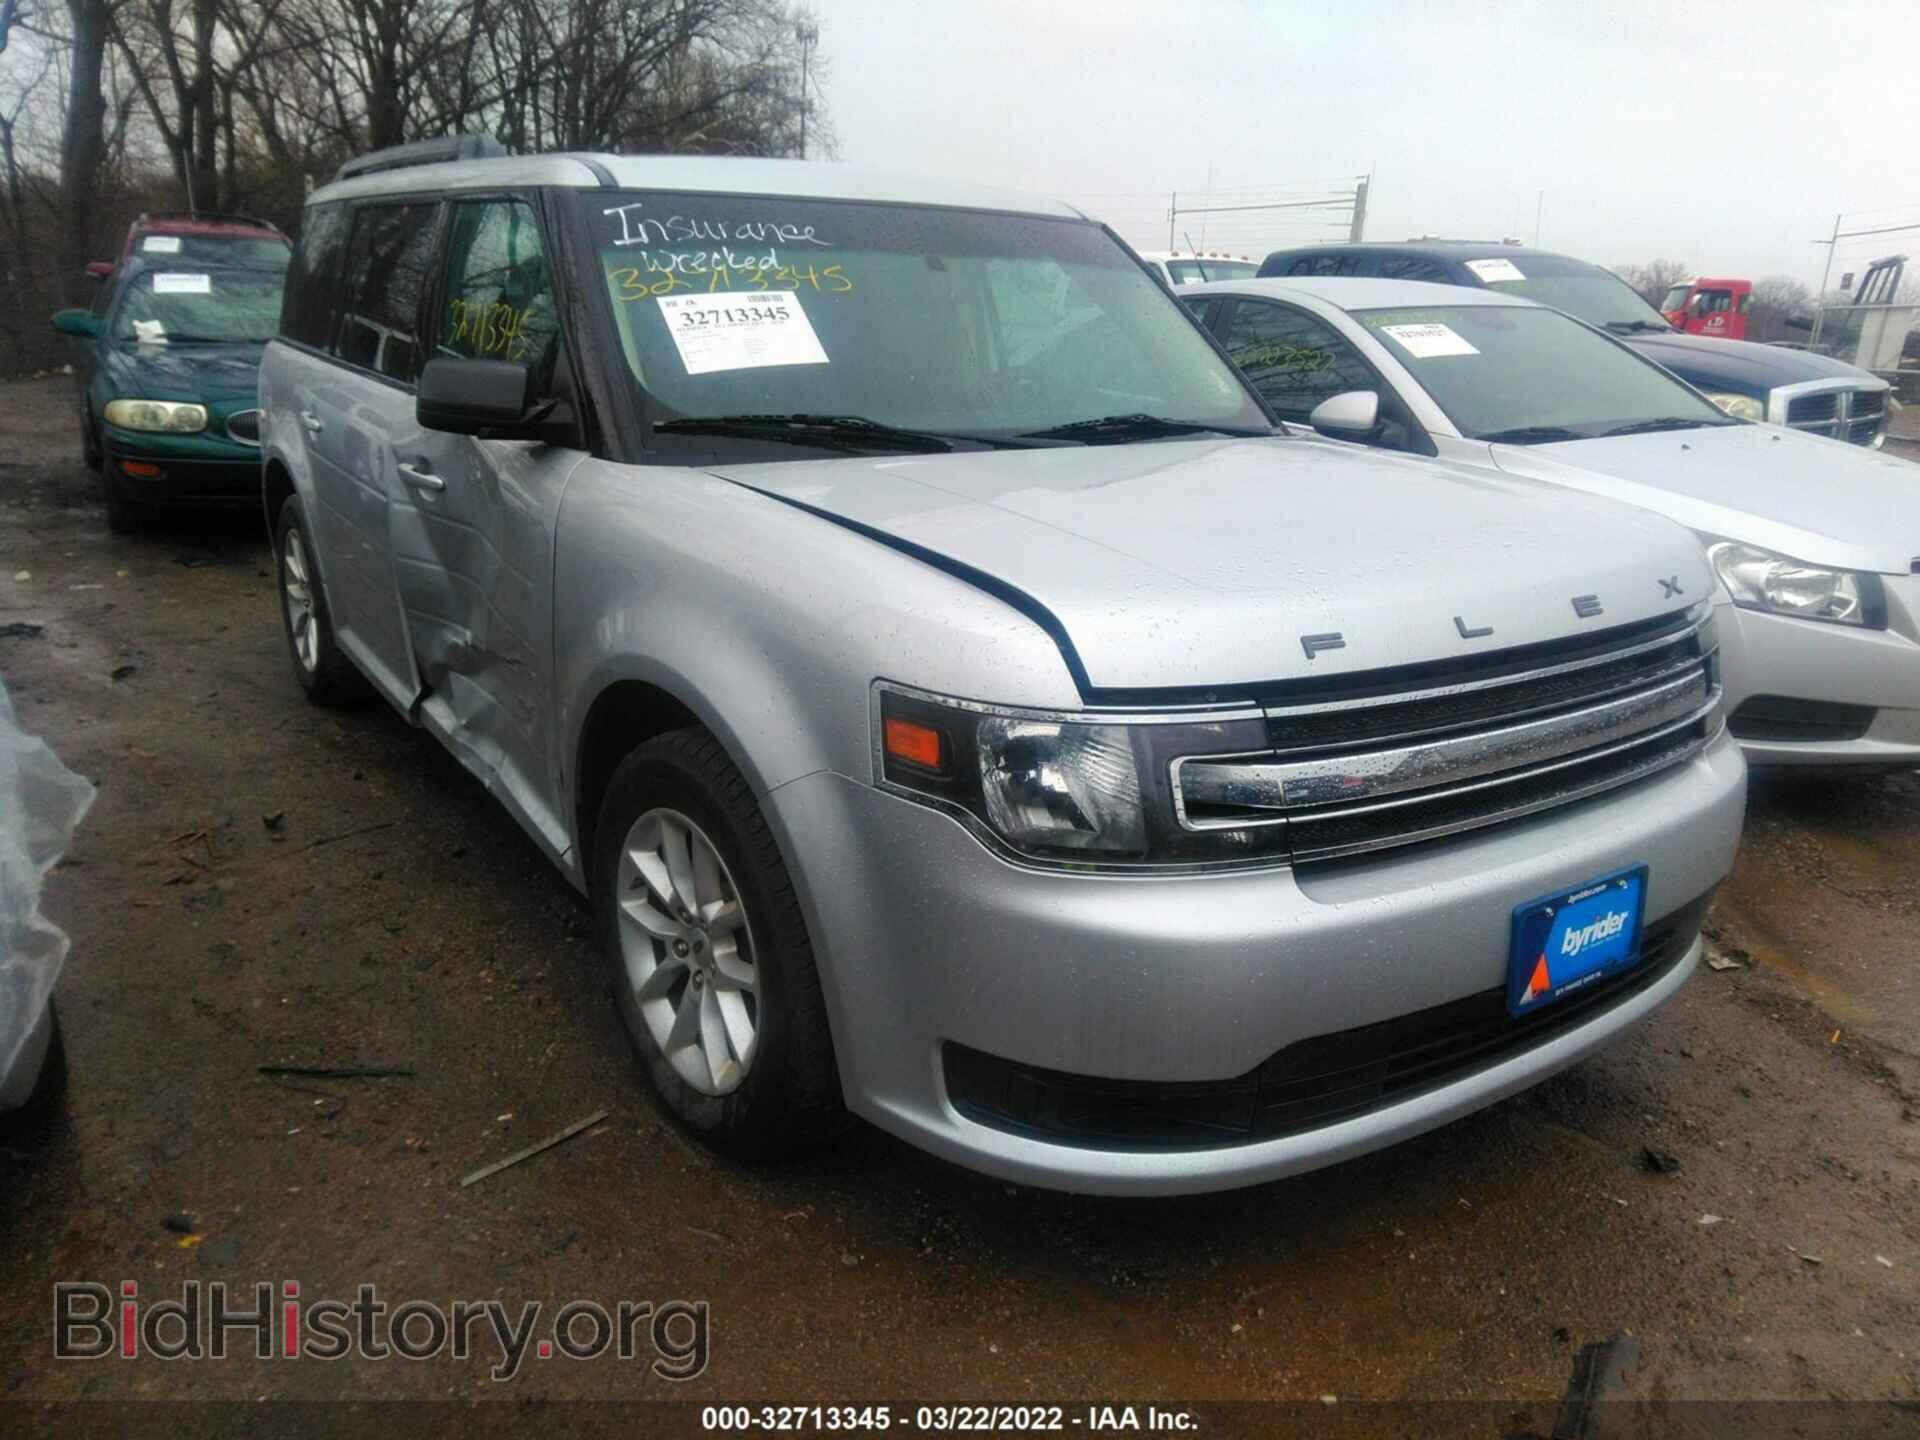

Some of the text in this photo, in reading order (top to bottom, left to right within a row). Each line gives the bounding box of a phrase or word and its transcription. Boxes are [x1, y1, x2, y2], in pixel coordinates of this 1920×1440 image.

[603, 203, 833, 246] Insurance
[680, 306, 790, 327] 32713345
[1300, 575, 1684, 660] FLEX
[1561, 910, 1630, 956] byrider
